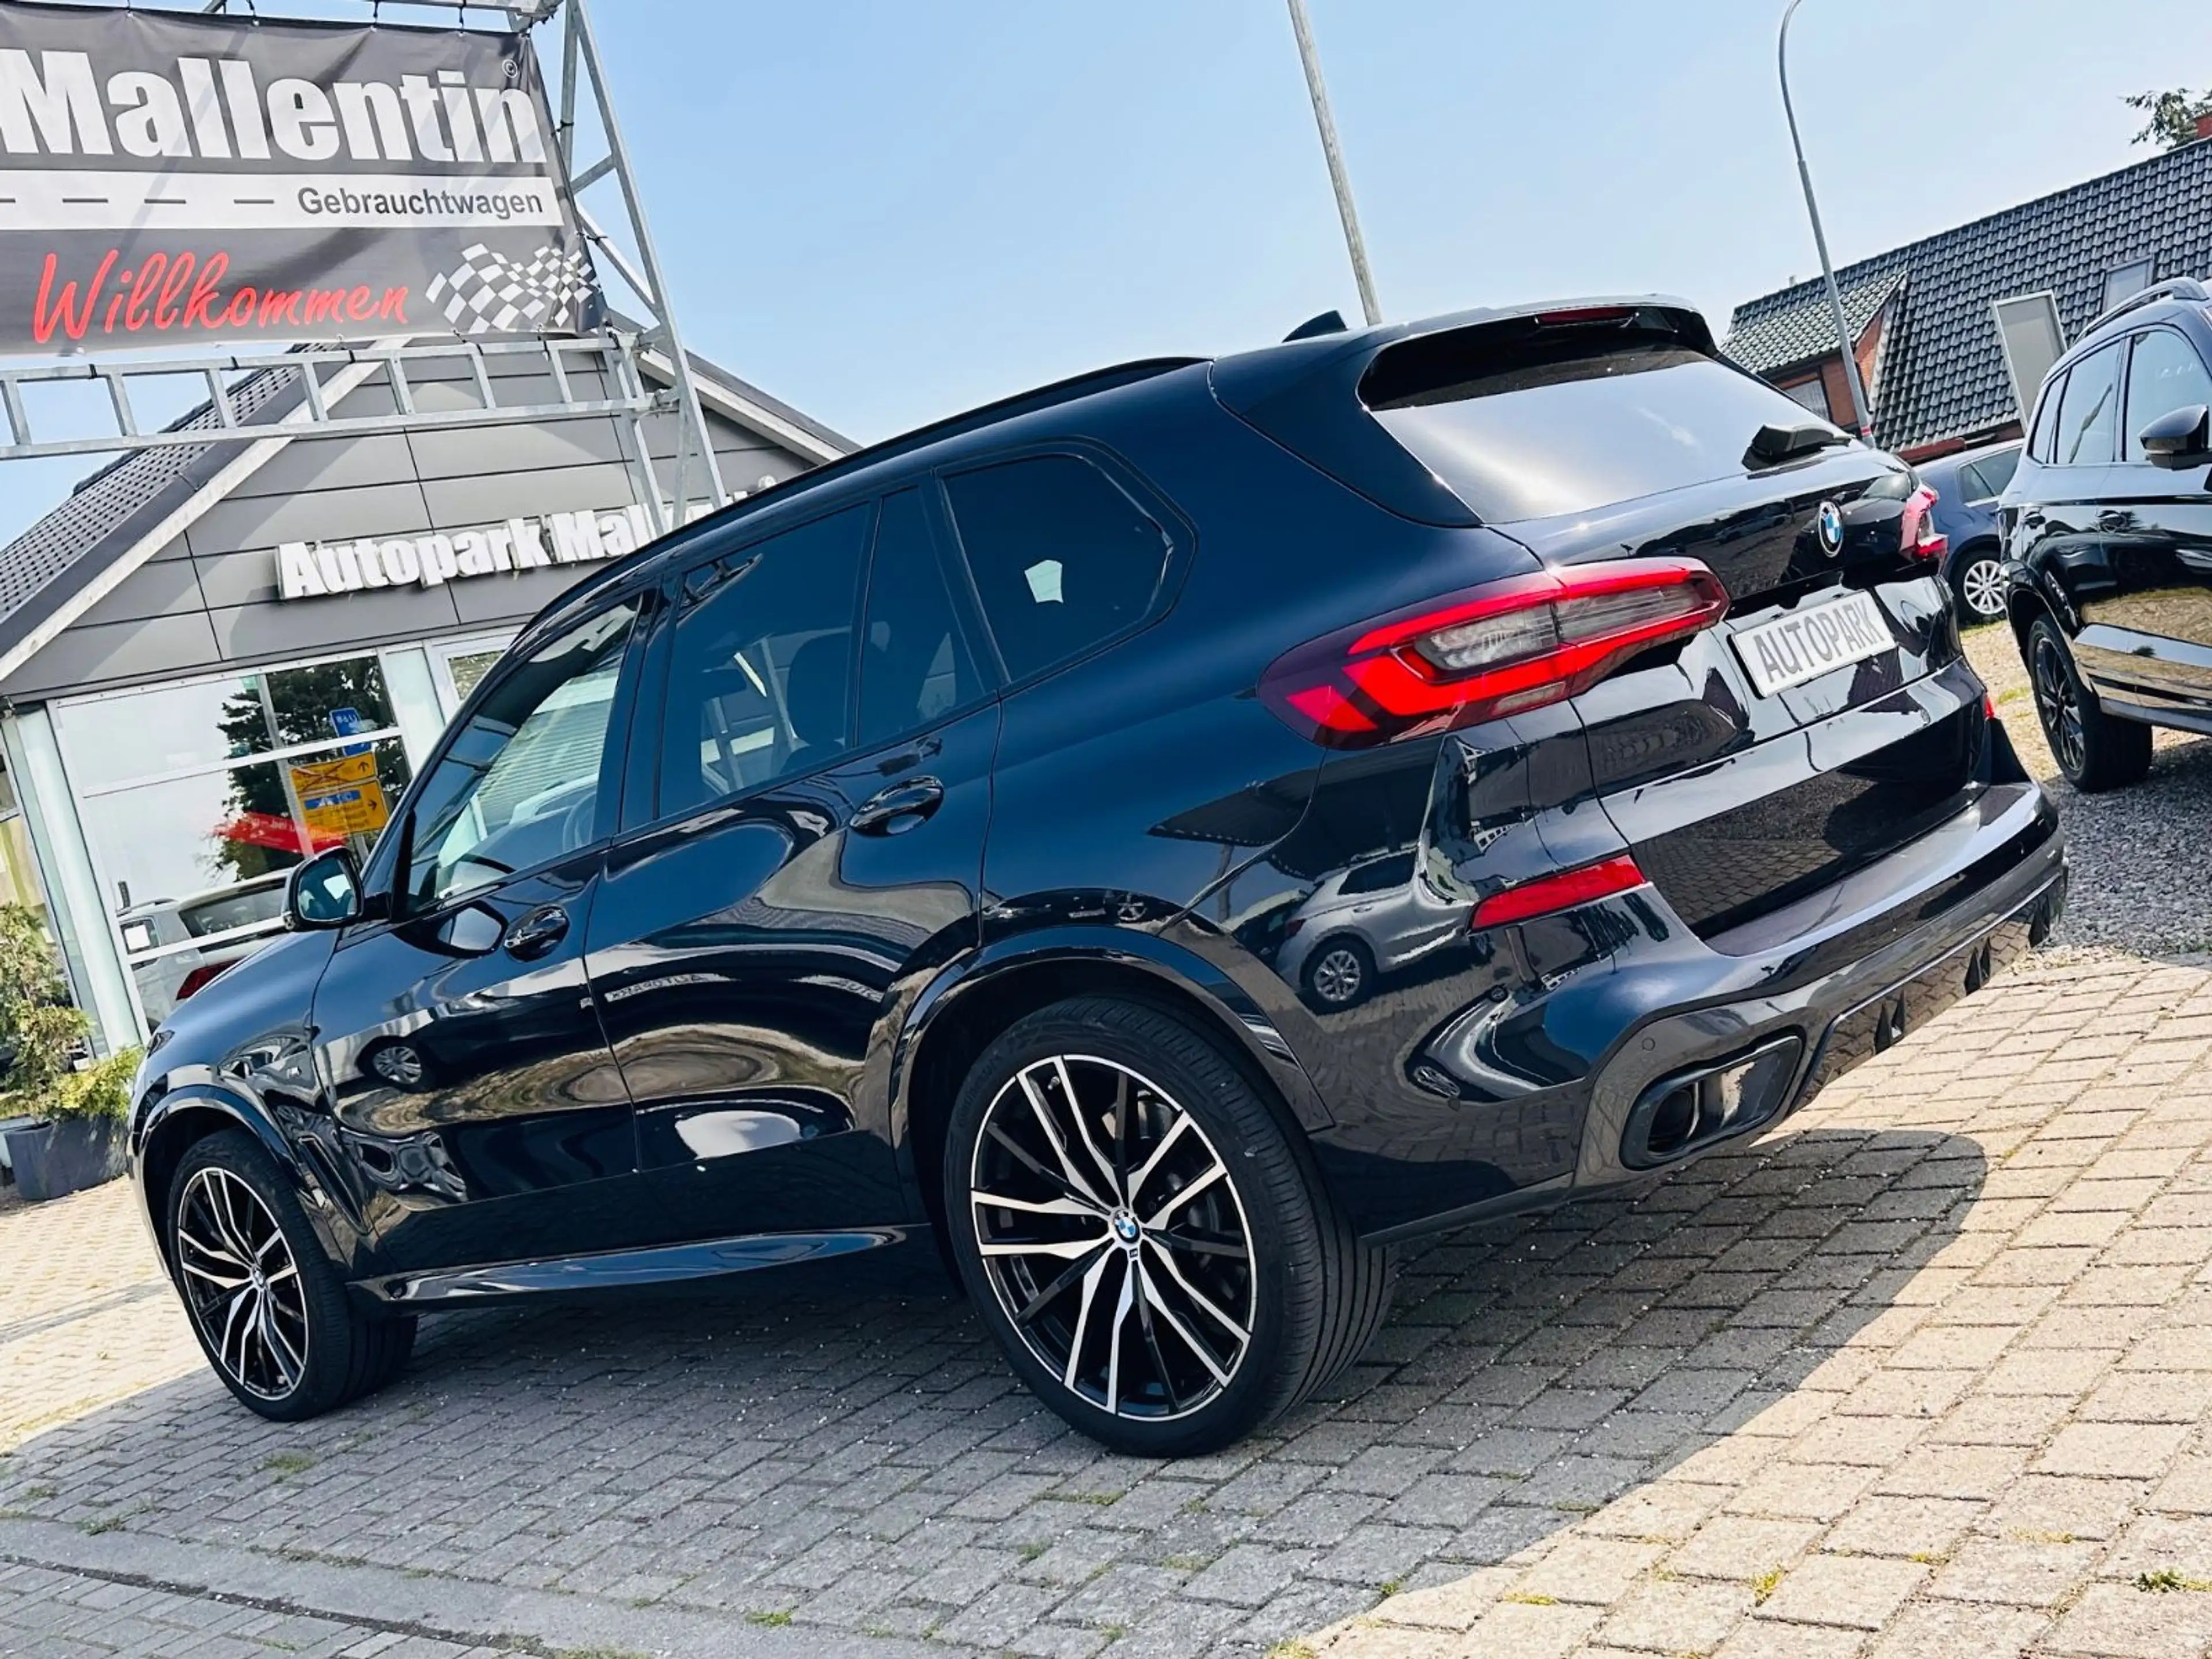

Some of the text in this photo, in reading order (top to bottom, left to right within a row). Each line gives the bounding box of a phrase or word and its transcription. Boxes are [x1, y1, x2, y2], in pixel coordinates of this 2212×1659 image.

[0, 48, 548, 163] Mallentin
[298, 186, 543, 219] Gebrauchtwagen
[33, 249, 408, 343] Willkommen
[278, 517, 553, 600] Autopark
[1753, 598, 1885, 683] AUTOPARK
